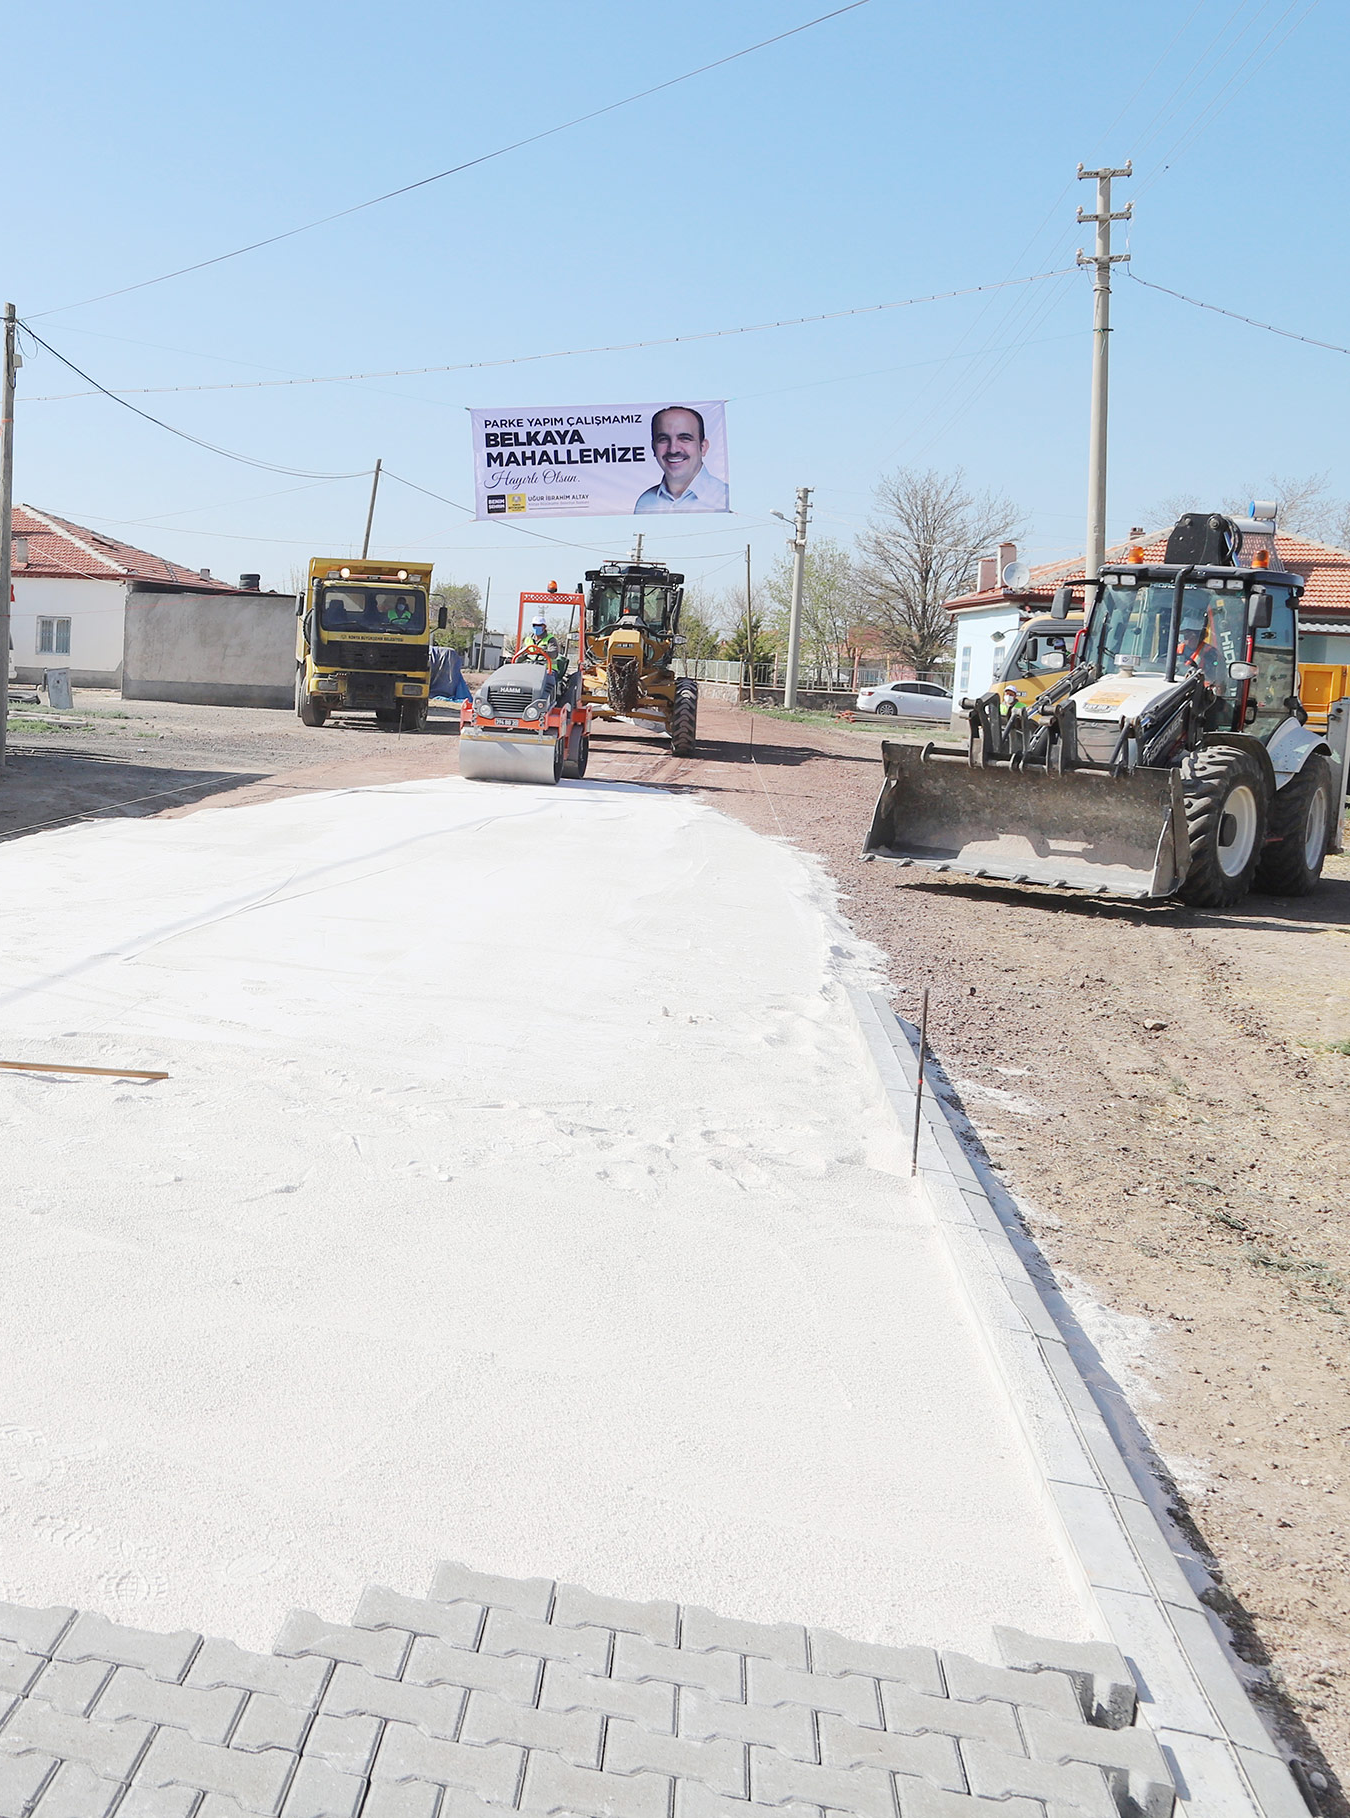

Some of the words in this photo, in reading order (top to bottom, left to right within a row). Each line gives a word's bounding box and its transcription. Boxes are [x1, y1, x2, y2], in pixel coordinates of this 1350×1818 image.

[484, 418, 524, 429] PARKE
[526, 417, 564, 427] YAPIM
[566, 414, 642, 427] ÇALIŞMAMIZ
[485, 429, 585, 448] BELKAYA
[486, 443, 646, 468] MAHALLEMİZE
[484, 469, 538, 490] Hayırlı
